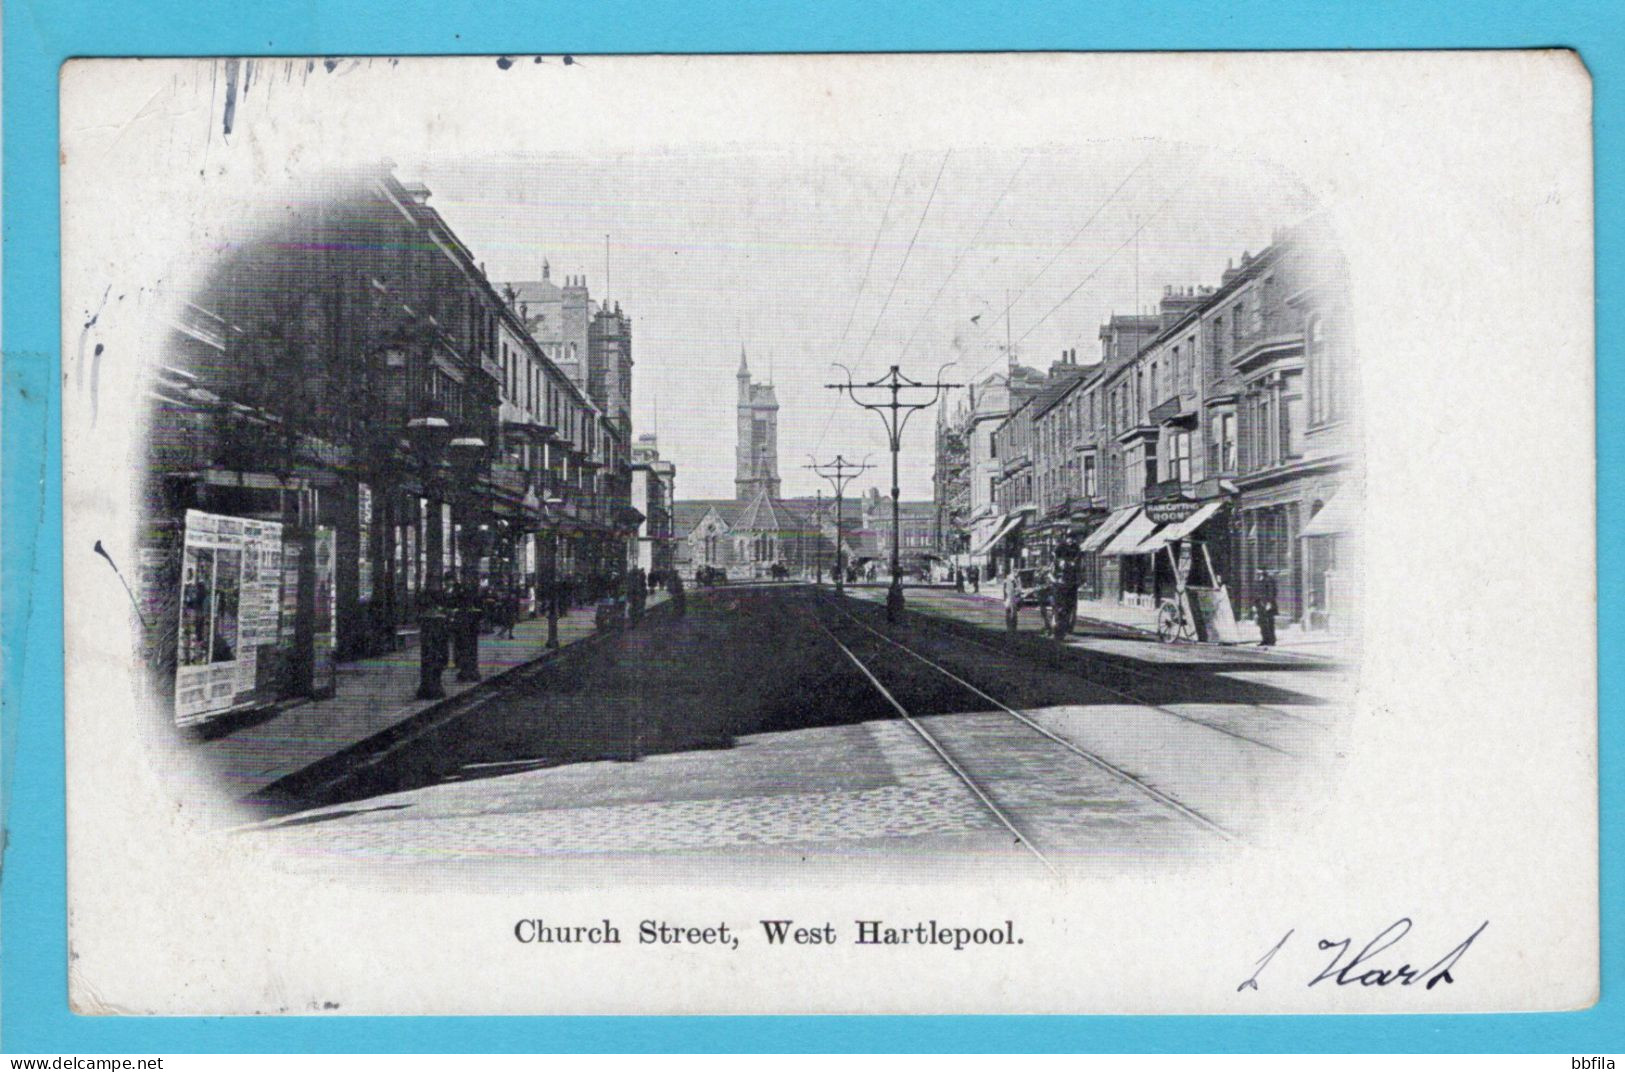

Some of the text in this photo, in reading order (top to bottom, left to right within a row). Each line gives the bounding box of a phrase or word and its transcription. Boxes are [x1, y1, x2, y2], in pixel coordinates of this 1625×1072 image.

[514, 919, 1024, 951] Church Street, West Hartlepool.
